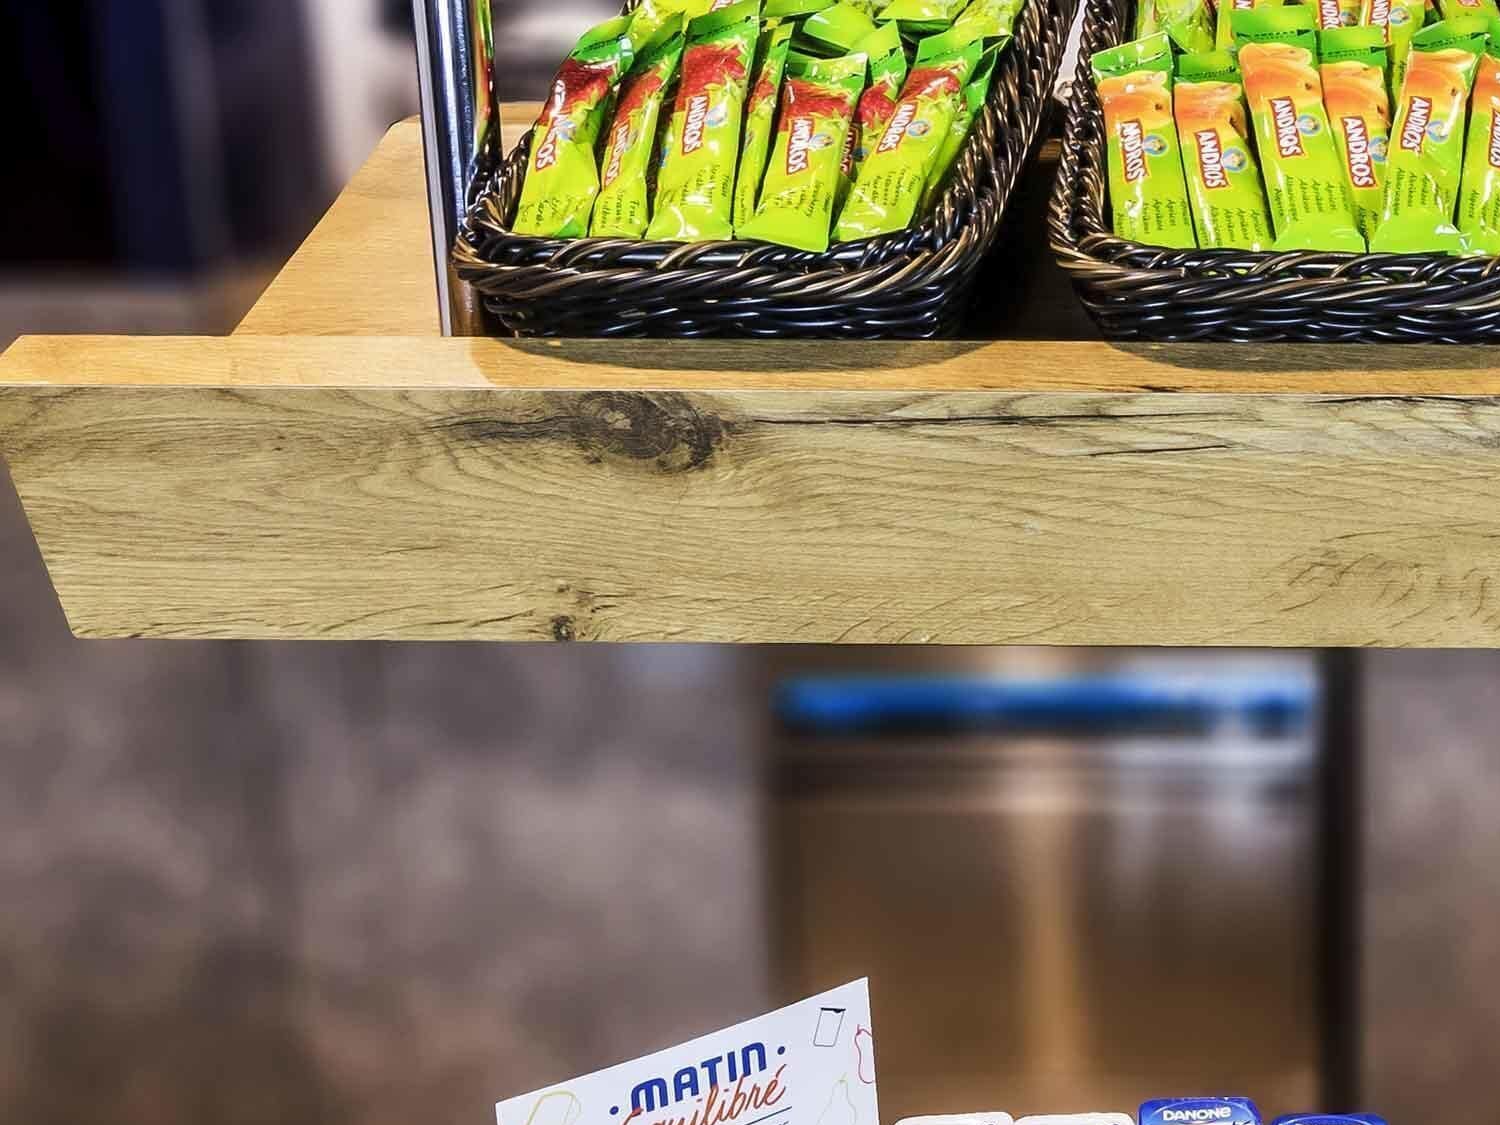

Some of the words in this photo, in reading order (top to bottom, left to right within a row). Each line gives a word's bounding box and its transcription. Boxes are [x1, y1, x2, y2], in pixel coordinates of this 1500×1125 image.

[1273, 100, 1302, 157] ANDROS
[1344, 118, 1374, 186] ANDROS
[1403, 97, 1429, 150] ANDROS
[1198, 131, 1226, 188] ANDROS
[630, 1041, 767, 1117] MATIN
